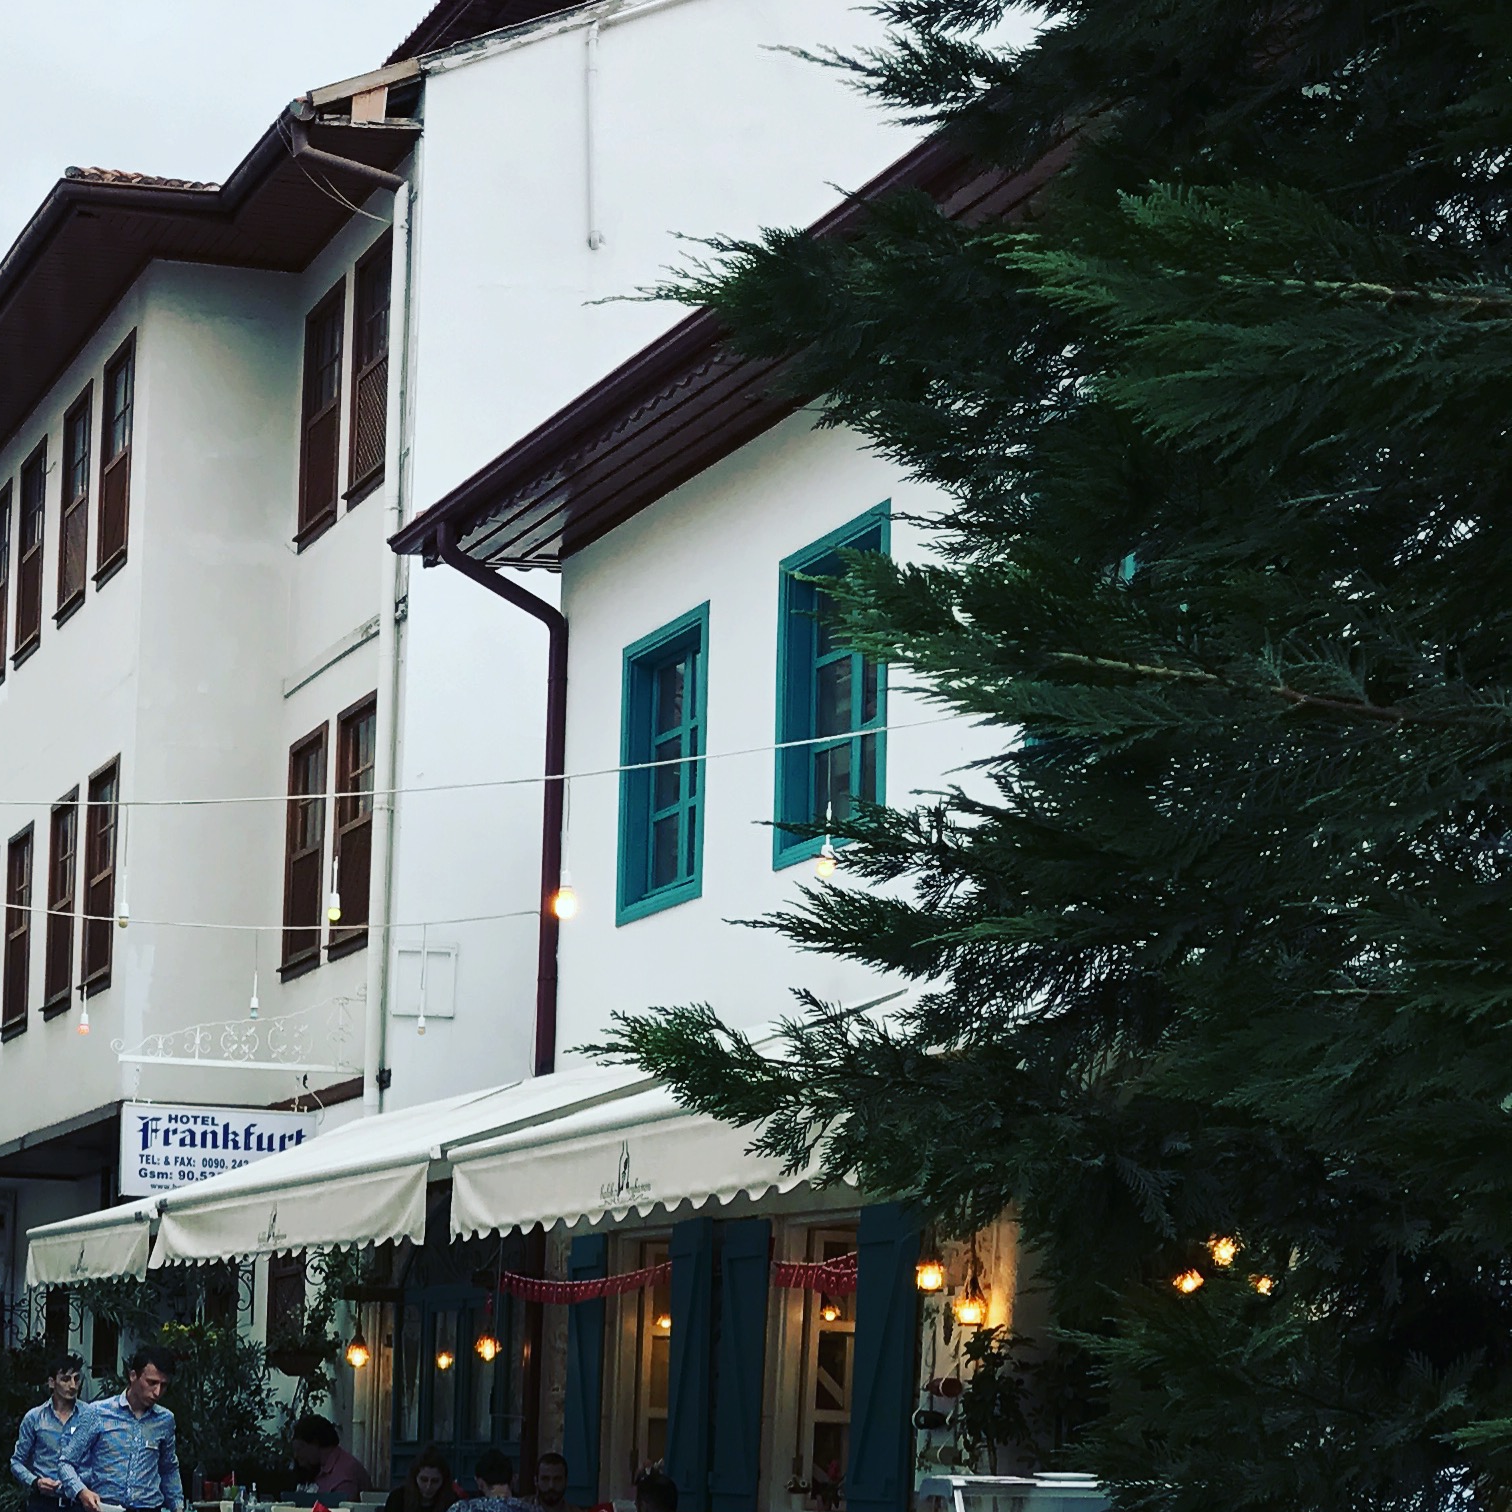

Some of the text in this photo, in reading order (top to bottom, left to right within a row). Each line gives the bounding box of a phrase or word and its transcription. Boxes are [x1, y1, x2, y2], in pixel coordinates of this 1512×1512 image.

[168, 1114, 219, 1127] HOTEL
[136, 1115, 307, 1152] Frankfurt
[139, 1154, 161, 1166] TEL:
[163, 1156, 171, 1166] &
[174, 1156, 196, 1168] FAX:
[138, 1168, 173, 1180] Gsm:
